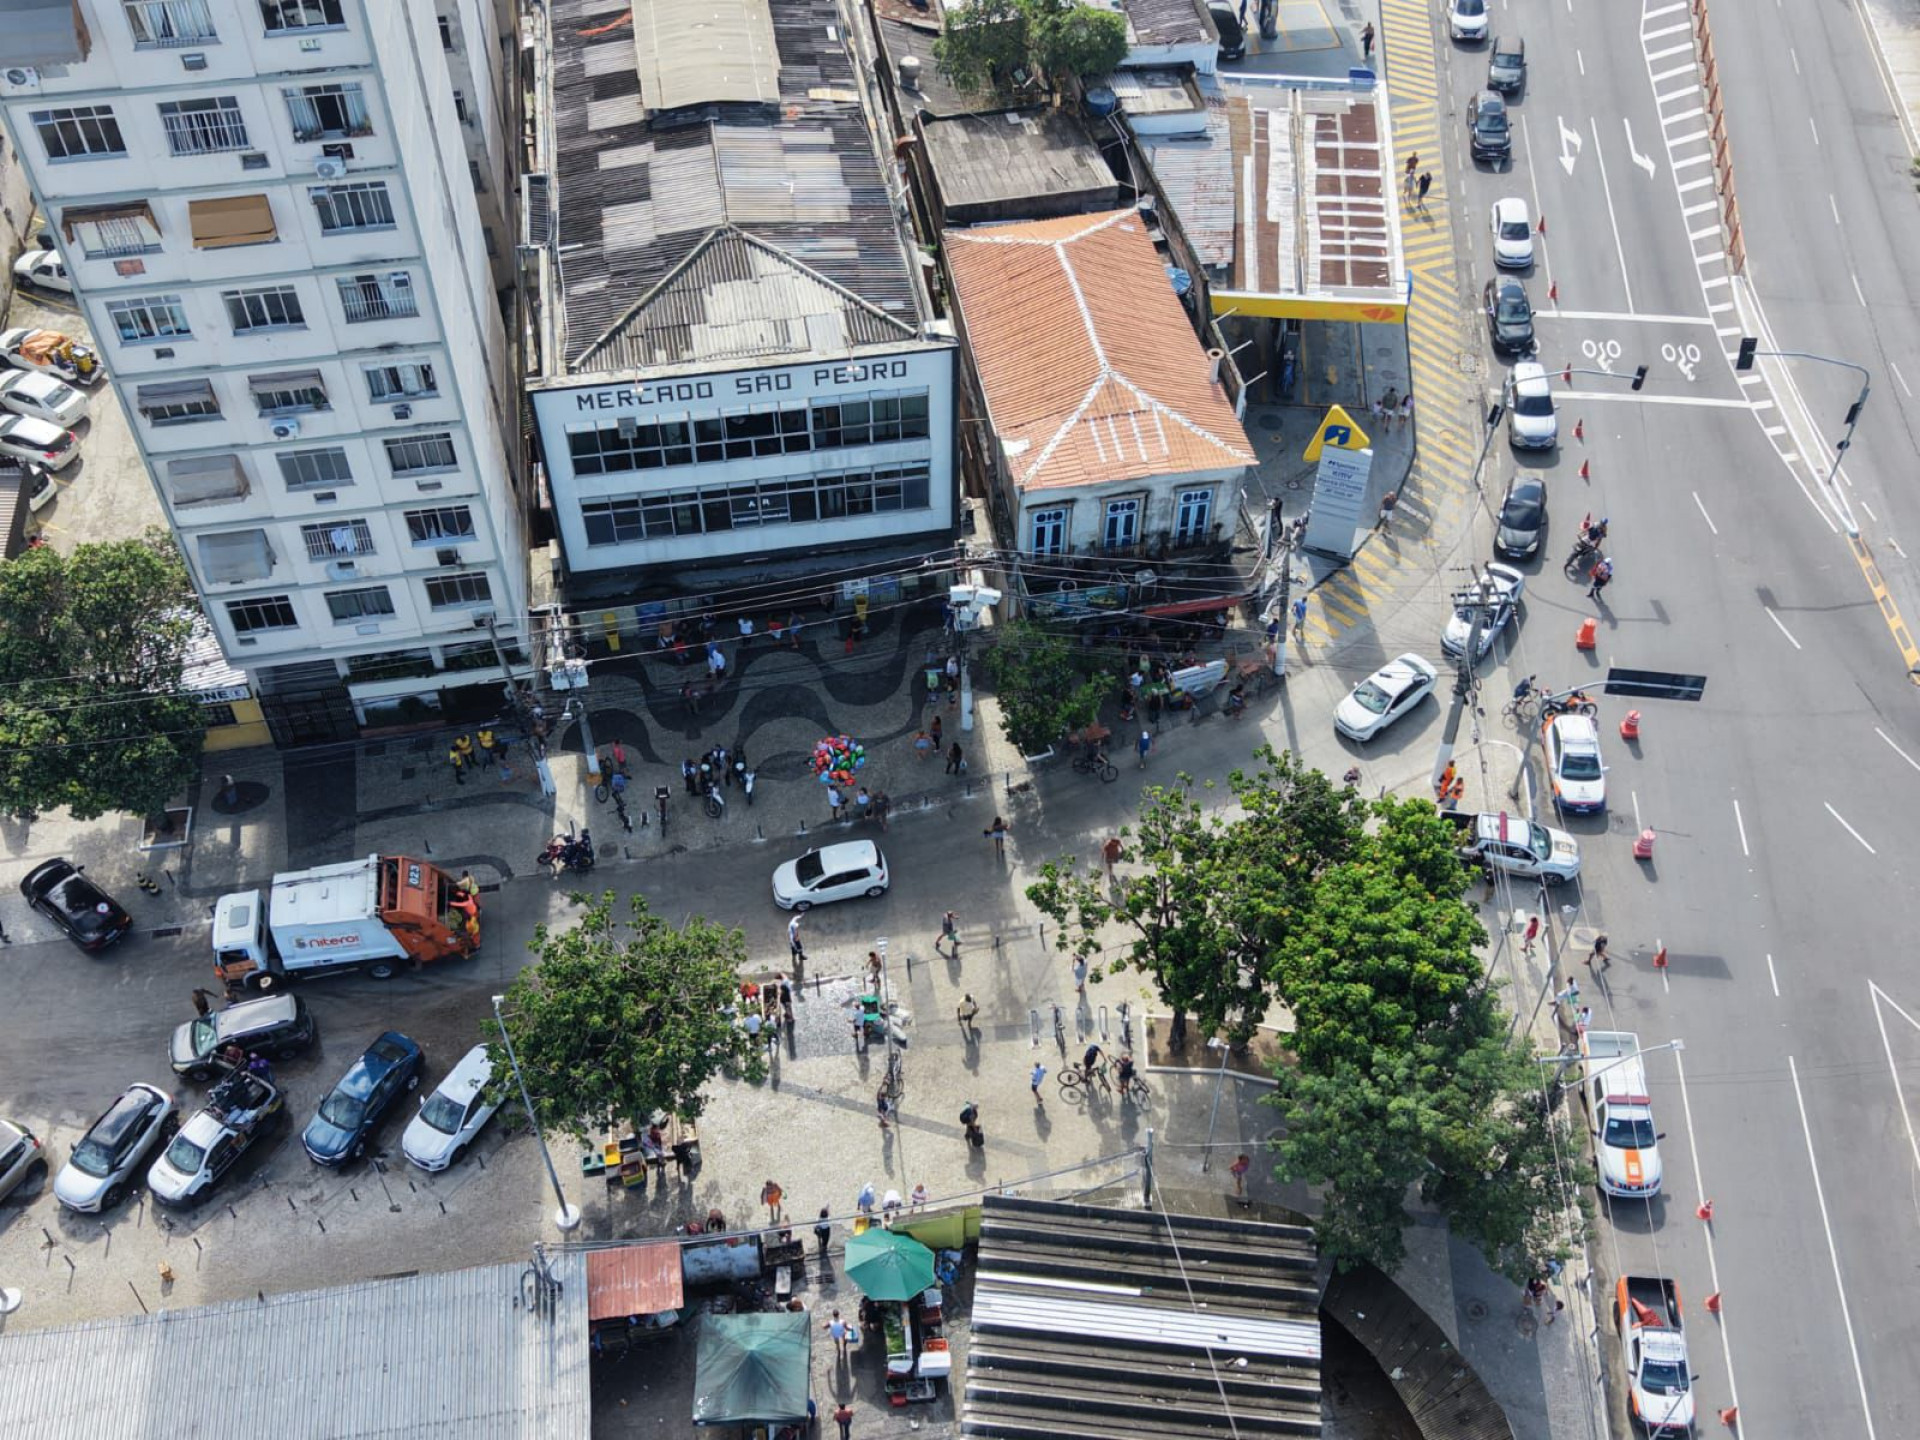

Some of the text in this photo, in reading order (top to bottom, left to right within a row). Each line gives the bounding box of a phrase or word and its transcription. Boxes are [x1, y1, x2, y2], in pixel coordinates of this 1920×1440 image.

[576, 360, 907, 411] MERCADO SÃO PEDRO
